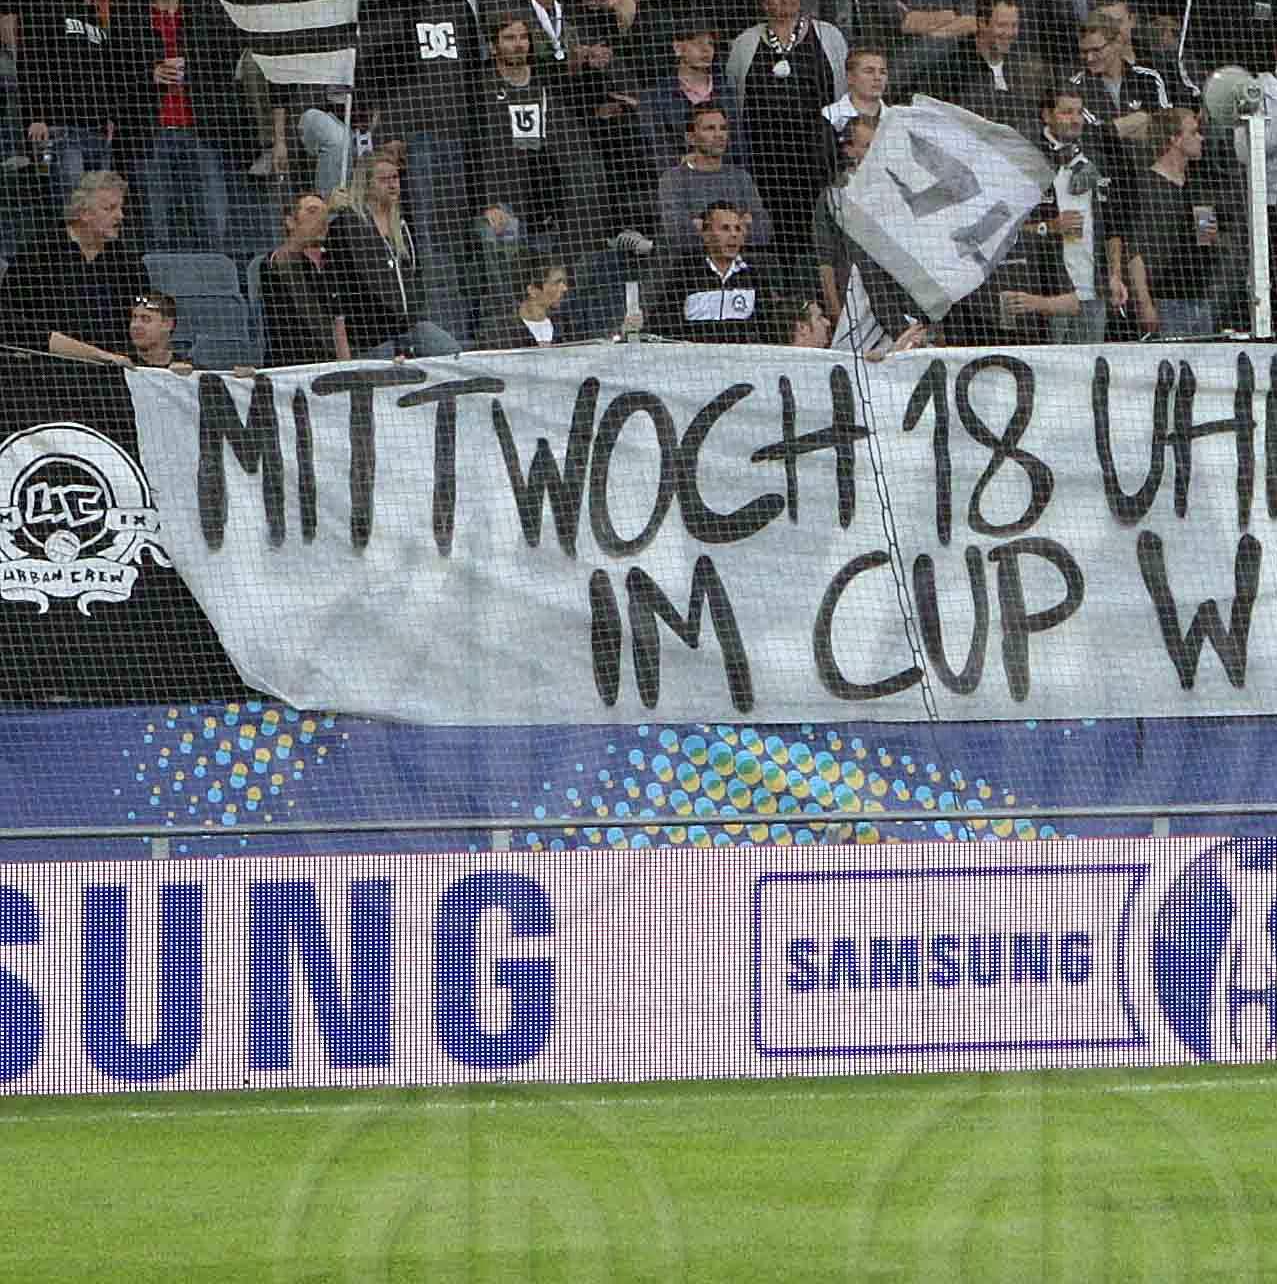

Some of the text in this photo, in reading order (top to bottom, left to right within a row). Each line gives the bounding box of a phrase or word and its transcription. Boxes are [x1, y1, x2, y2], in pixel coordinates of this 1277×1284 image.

[196, 368, 870, 559] MITTWOCH
[902, 353, 1055, 546] 18
[3, 566, 126, 585] URBAN CREW
[589, 554, 756, 712] IM
[811, 536, 1086, 702] CUP
[786, 928, 1092, 991] SAMSUNG
